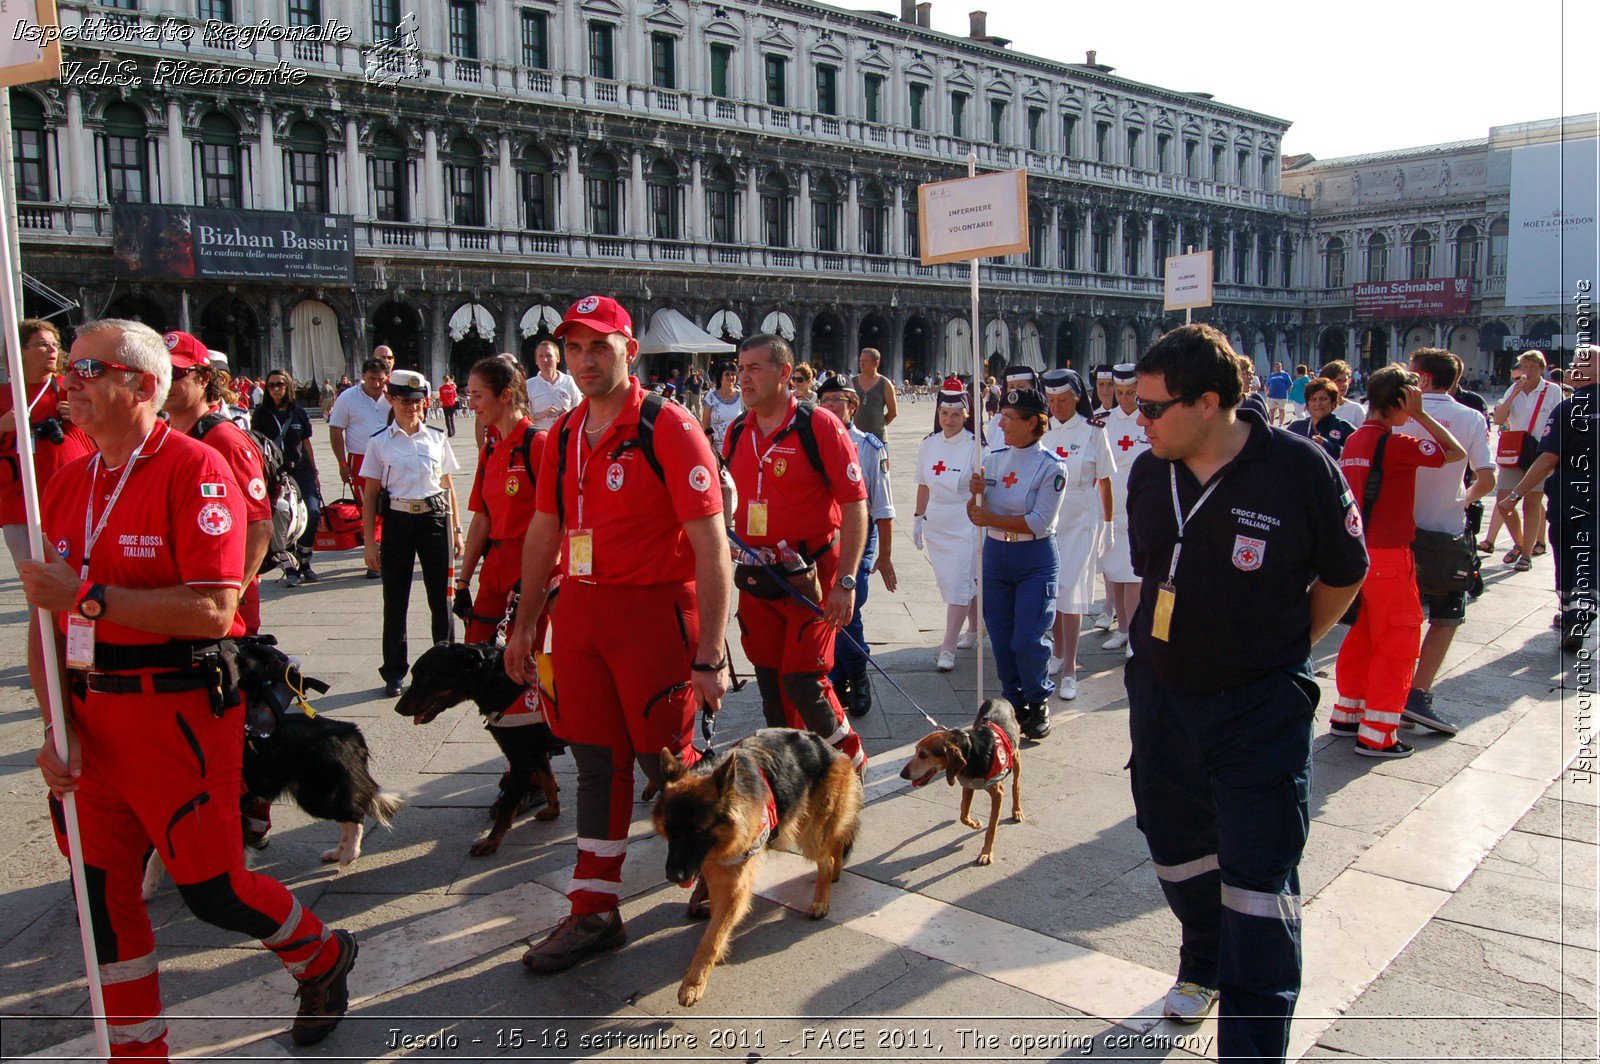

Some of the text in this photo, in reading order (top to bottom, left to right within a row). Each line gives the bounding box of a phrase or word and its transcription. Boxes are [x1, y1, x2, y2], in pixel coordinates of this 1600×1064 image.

[948, 203, 992, 217] INFERMIERE
[948, 220, 994, 233] VOLONTARIE
[198, 225, 349, 252] Bizhan Bassiri
[200, 247, 303, 260] La caduta delle meteoriti
[1355, 281, 1445, 295] Julian Schnabel
[1520, 337, 1551, 348] Media
[1231, 507, 1281, 527] CROCE ROSSA
[1237, 516, 1270, 531] ITALIANA
[118, 534, 164, 546] CROCE ROSSA
[123, 546, 156, 558] ITALIANA
